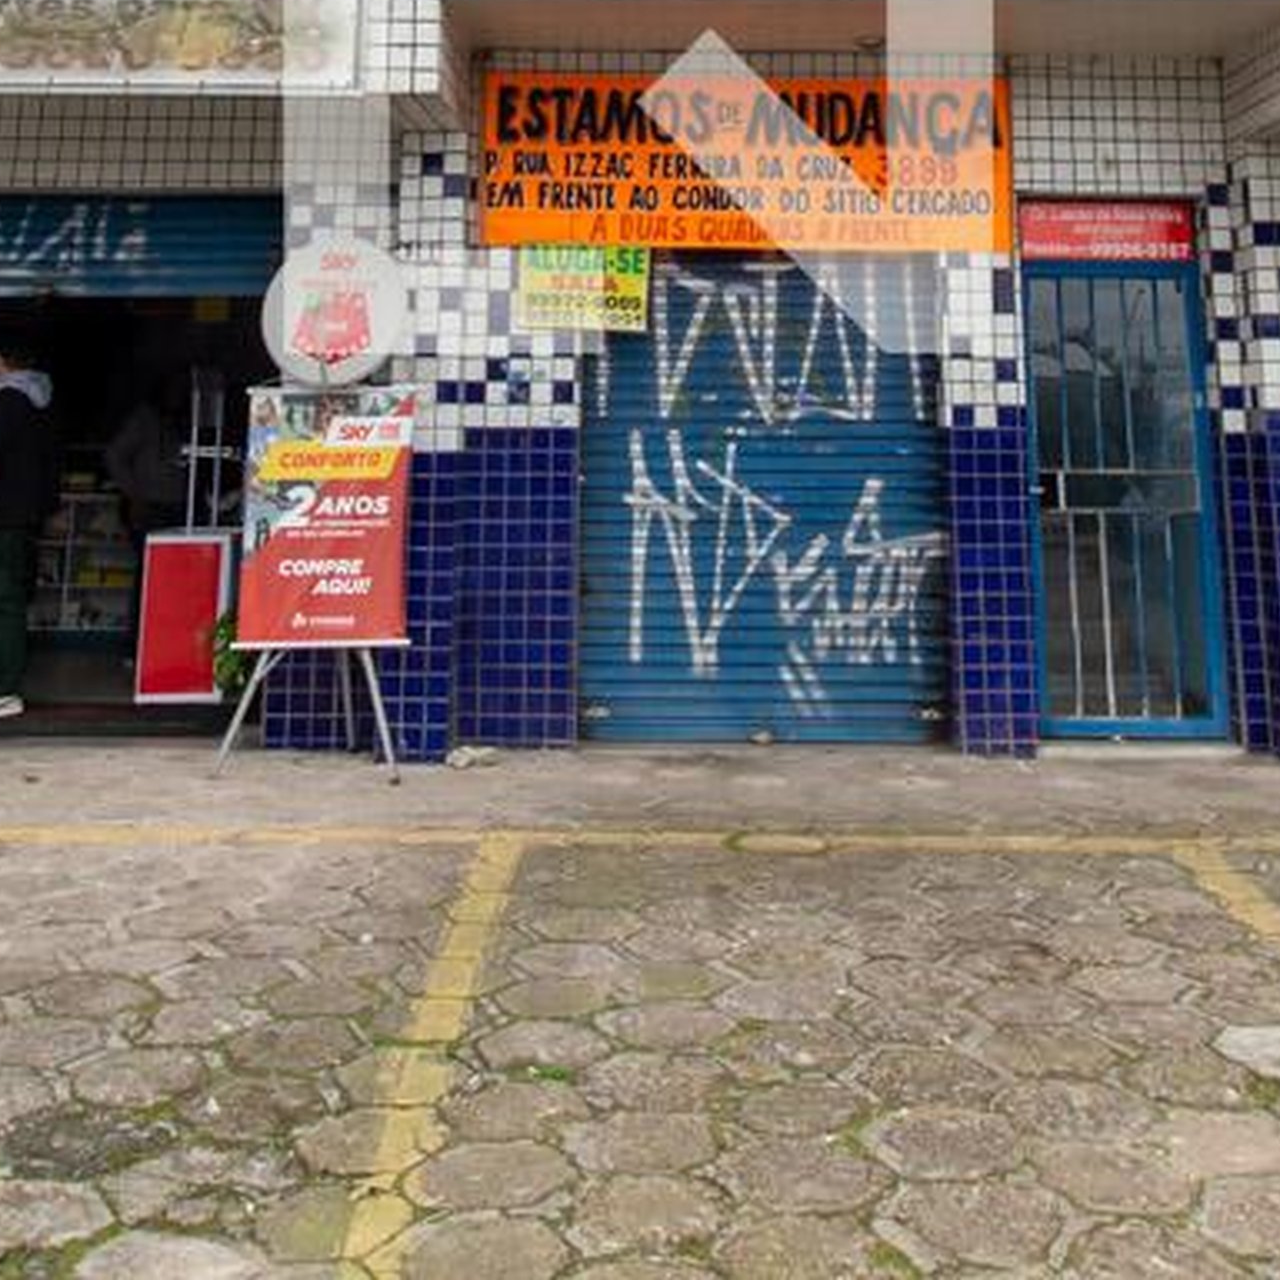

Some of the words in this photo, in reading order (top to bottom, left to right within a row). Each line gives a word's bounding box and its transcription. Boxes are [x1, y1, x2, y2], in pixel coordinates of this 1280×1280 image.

[497, 86, 712, 143] ESTAMOS
[746, 90, 1002, 158] MUDANÇA
[513, 151, 552, 176] RUA
[757, 156, 784, 180] DA
[797, 154, 853, 181] CRUZ
[486, 182, 524, 208] EM
[538, 181, 616, 209] FRENTE
[629, 182, 659, 211] AO
[672, 184, 764, 211] CONDOR
[778, 187, 810, 213] DO
[620, 215, 687, 242] DUAS
[336, 423, 374, 441] SKY
[276, 485, 316, 528] 2
[314, 495, 391, 517] ANOS
[279, 558, 365, 577] COMPRE
